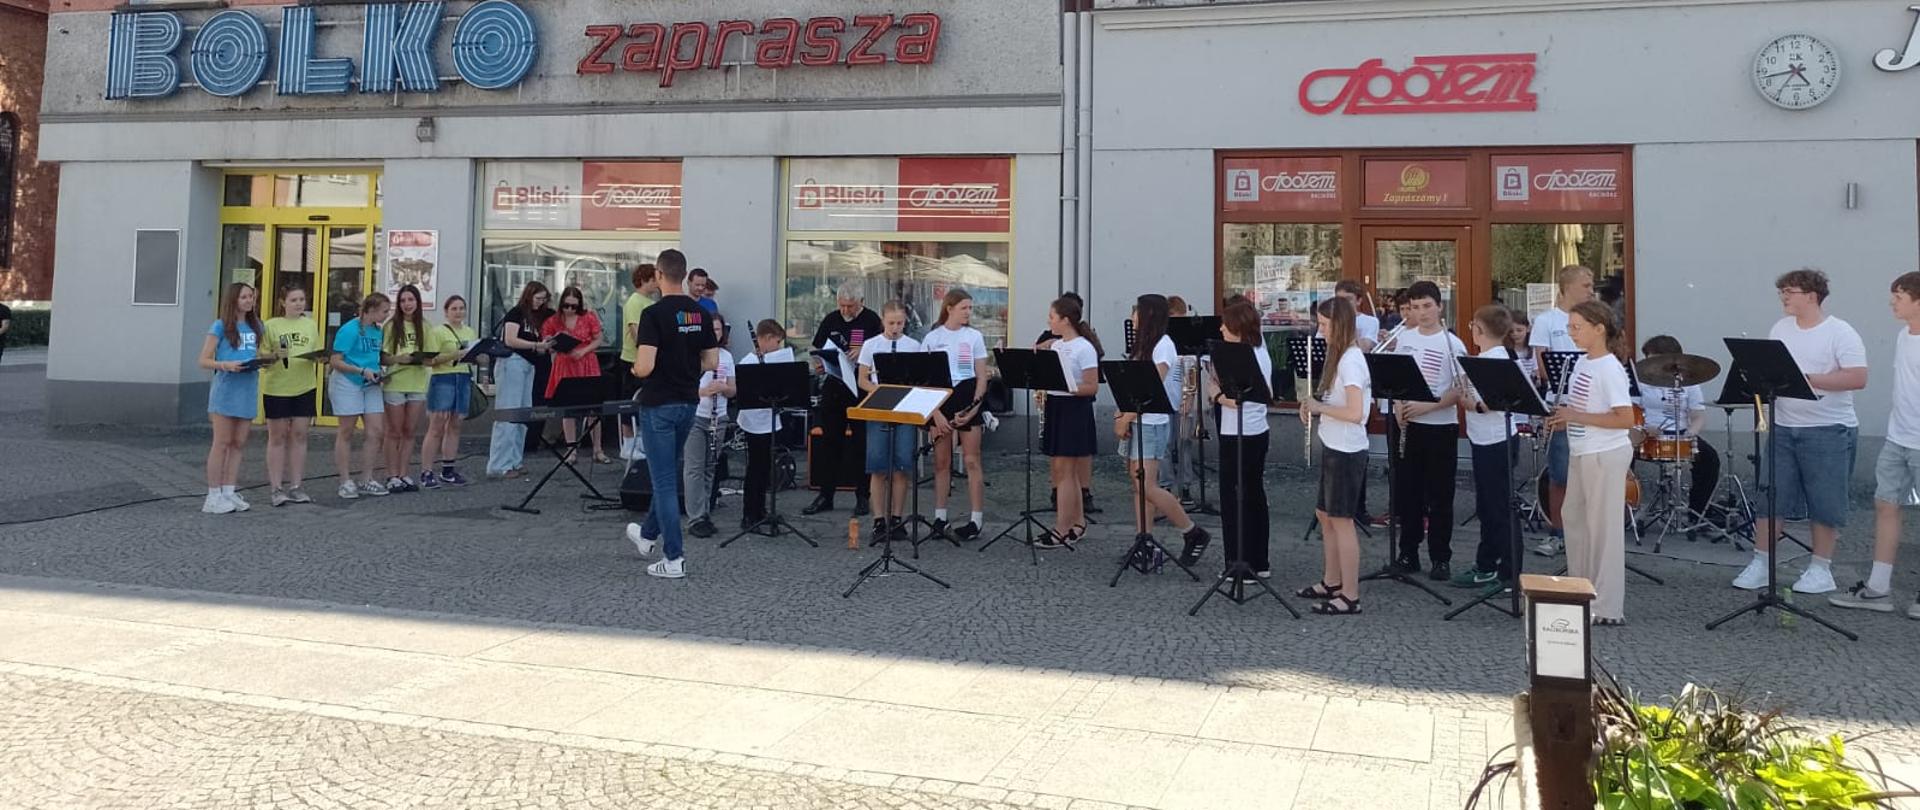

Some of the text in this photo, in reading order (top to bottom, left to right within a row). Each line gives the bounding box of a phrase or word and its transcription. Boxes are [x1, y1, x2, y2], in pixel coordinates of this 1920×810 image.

[576, 12, 942, 88] zaprasza
[1775, 43, 1785, 53] 11
[1790, 40, 1801, 49] 12
[1766, 56, 1777, 65] 10
[515, 185, 570, 205] Bliski
[823, 185, 885, 204] Bliski
